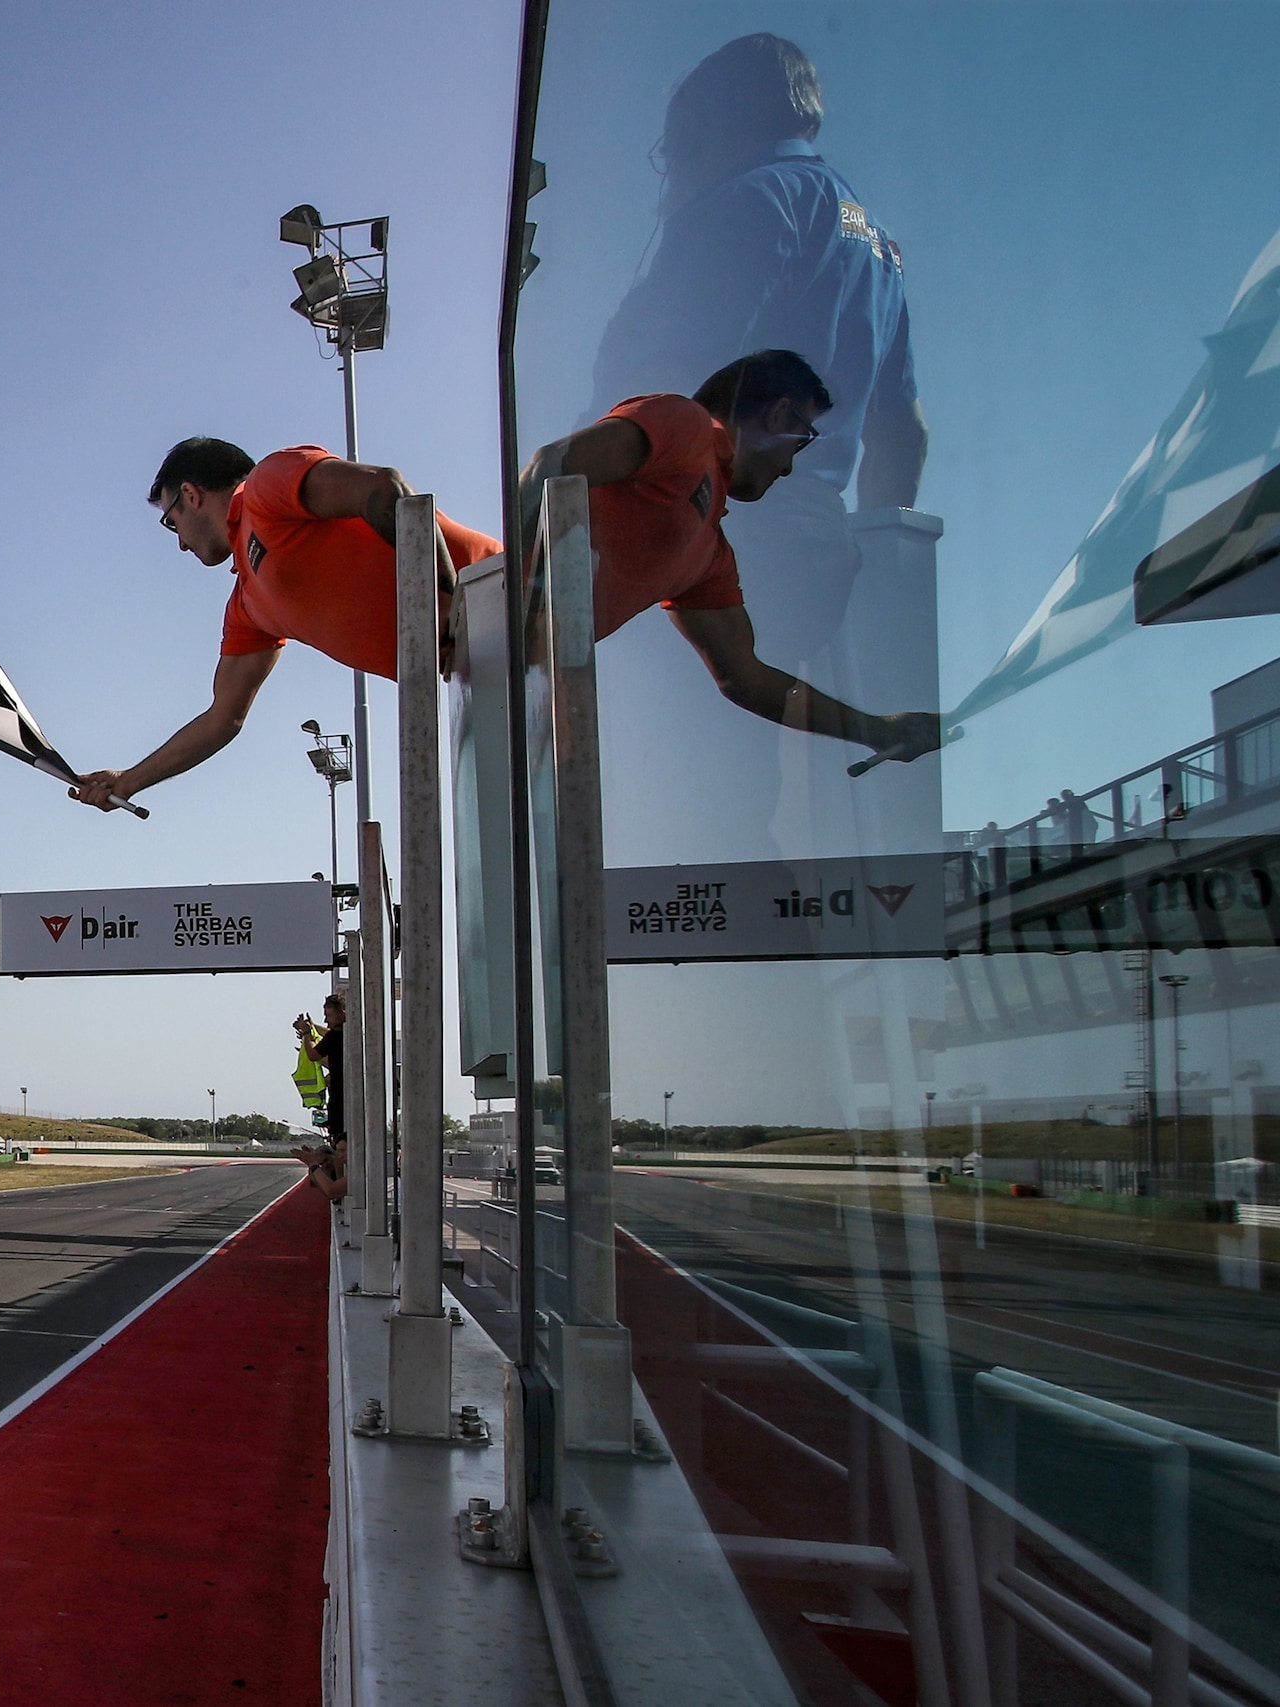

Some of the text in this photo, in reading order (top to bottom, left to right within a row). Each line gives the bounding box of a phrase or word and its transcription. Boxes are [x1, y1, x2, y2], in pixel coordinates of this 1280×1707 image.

[841, 207, 866, 230] 24H
[173, 902, 213, 917] THE
[173, 916, 253, 933] AIRBAG
[173, 931, 252, 947] SYSTEM
